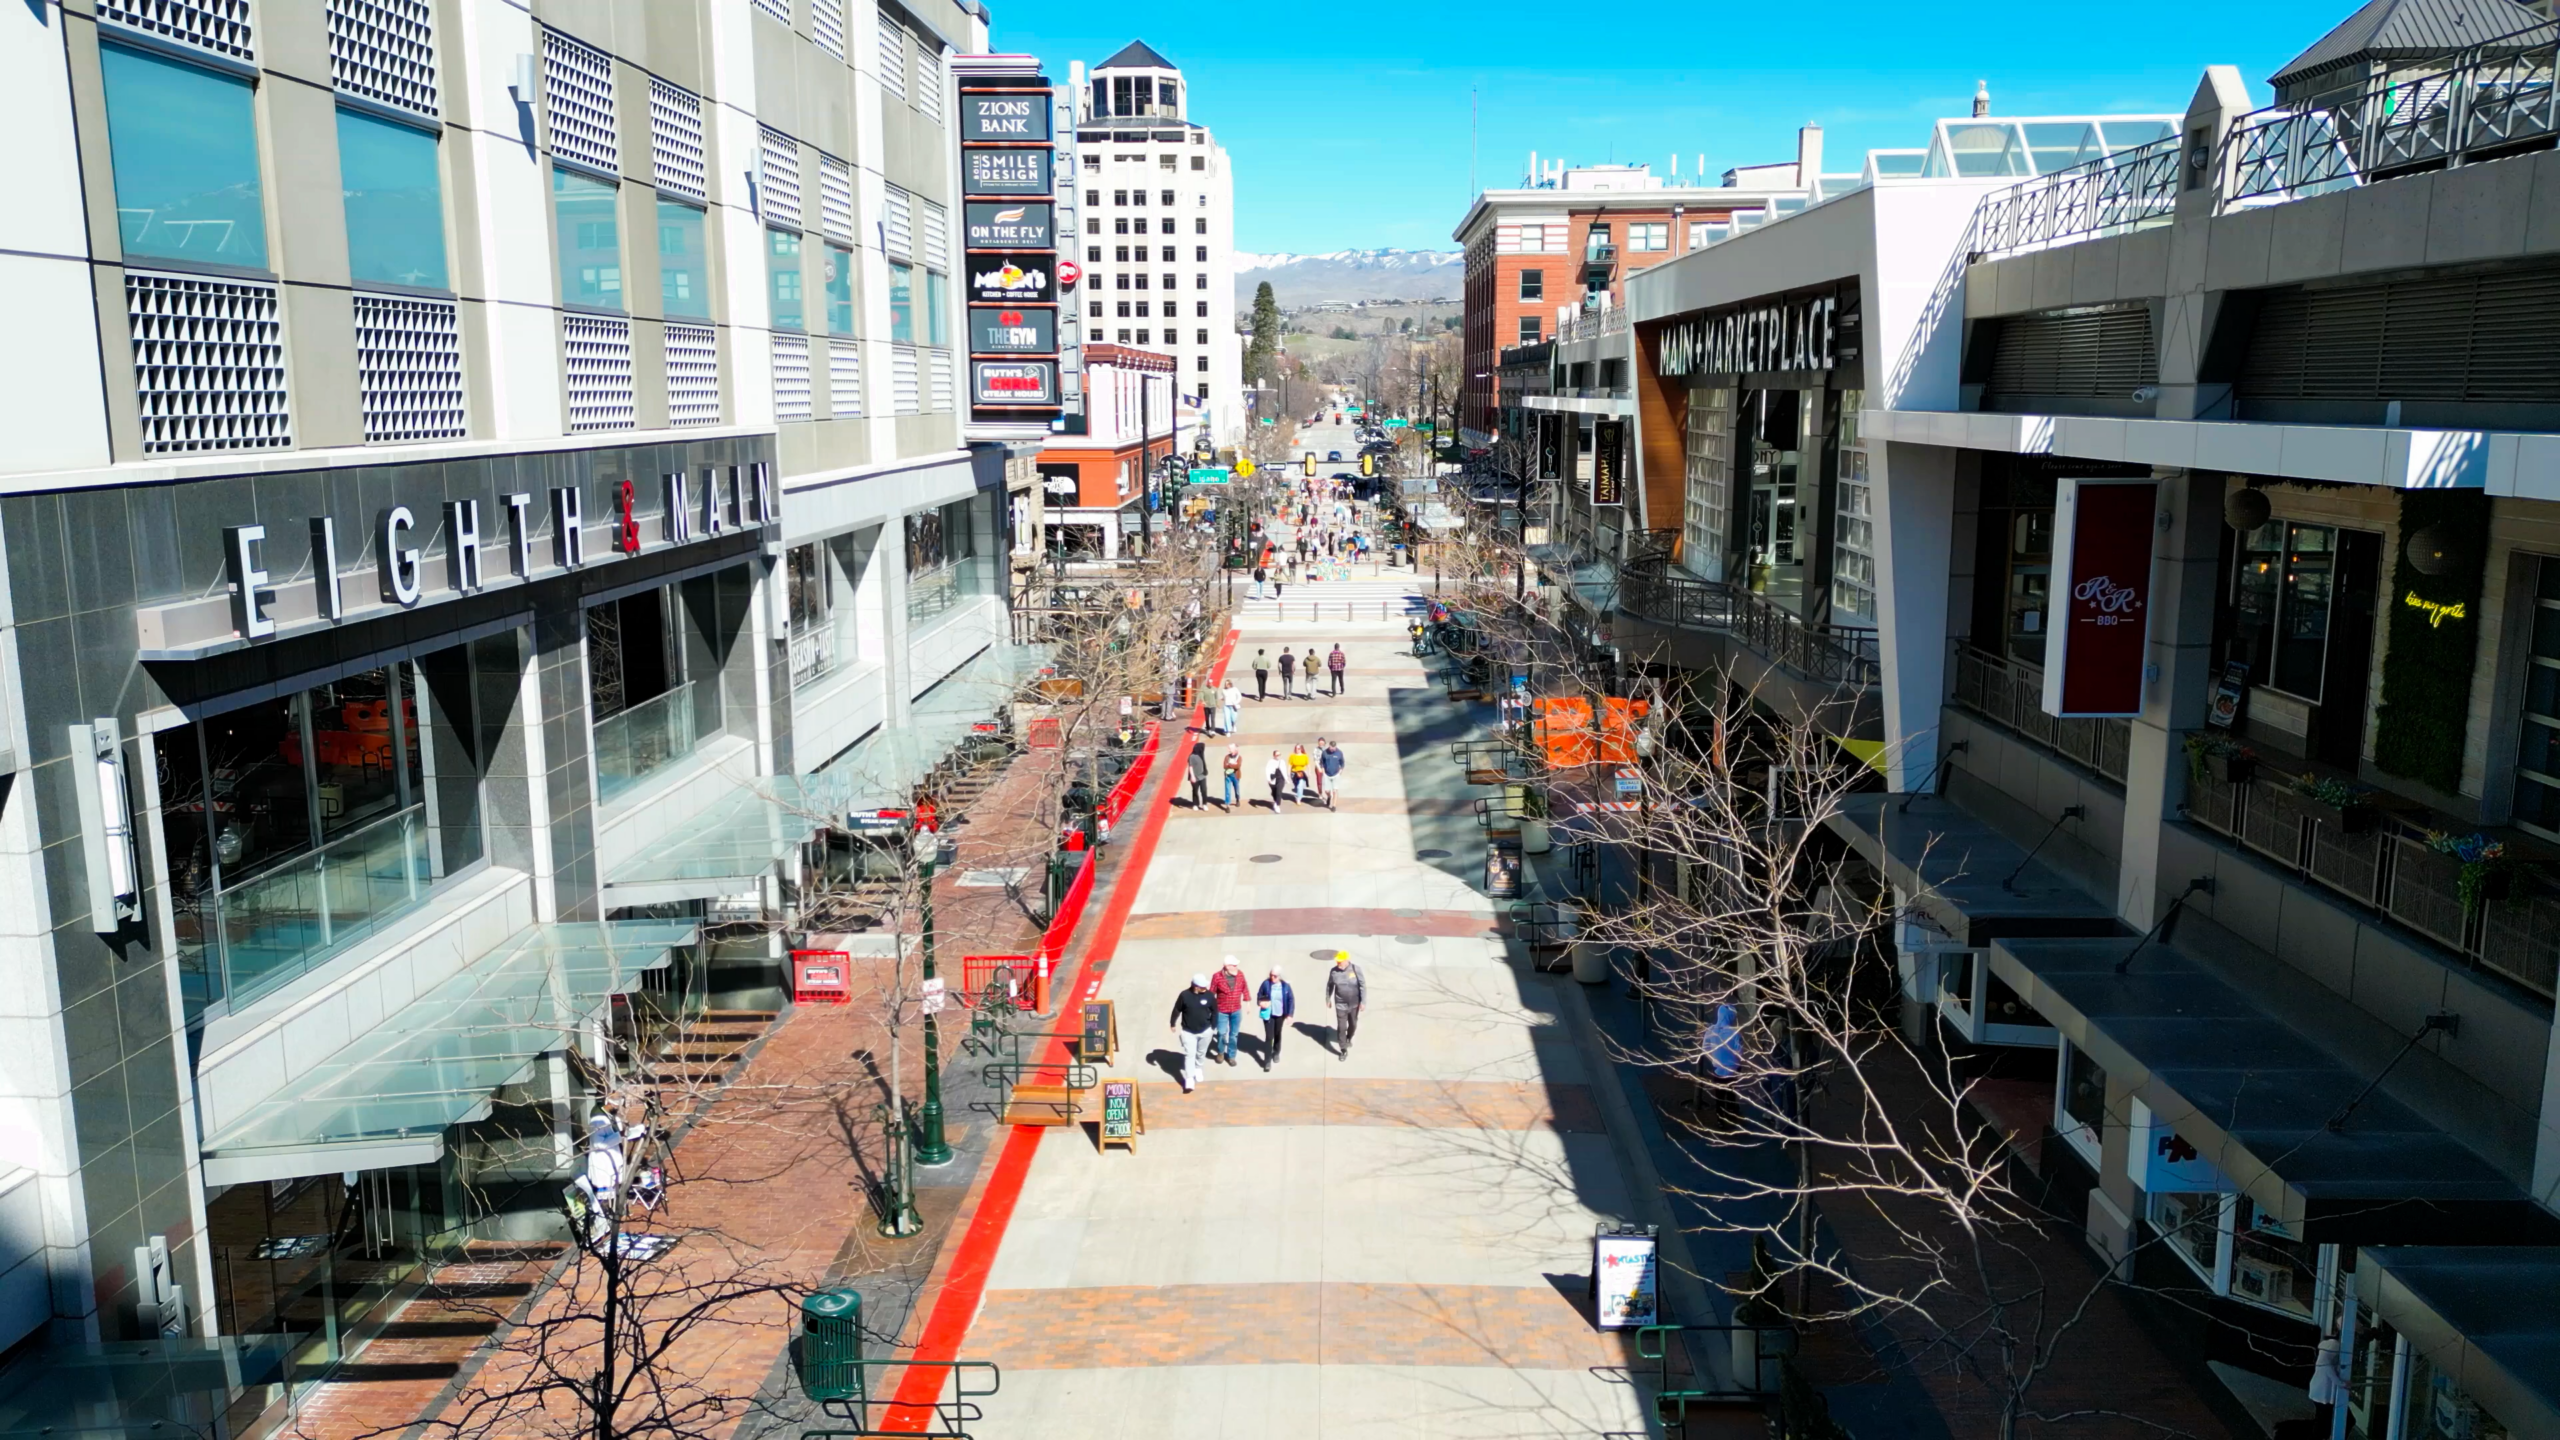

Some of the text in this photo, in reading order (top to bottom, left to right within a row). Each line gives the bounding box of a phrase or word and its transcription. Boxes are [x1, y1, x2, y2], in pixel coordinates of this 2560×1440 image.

[978, 102, 1030, 116] ZIONS
[981, 119, 1028, 133] BANK
[972, 155, 980, 180] BOISE
[981, 155, 1038, 168] SMILE
[981, 169, 1038, 180] DESIGN
[971, 226, 1045, 238] ON THE FLY
[1659, 321, 1694, 376] MAIN
[1704, 297, 1836, 375] MARKETPLACE
[983, 368, 1023, 378] RUTH'S
[988, 377, 1040, 391] CHRIS
[982, 390, 1044, 398] STEAK HOUSE
[226, 485, 585, 641] EIGHTH
[662, 461, 773, 543] MAIN
[2097, 615, 2118, 626] BBQ
[1106, 1084, 1131, 1096] MOONS
[1109, 1098, 1127, 1109] NOW
